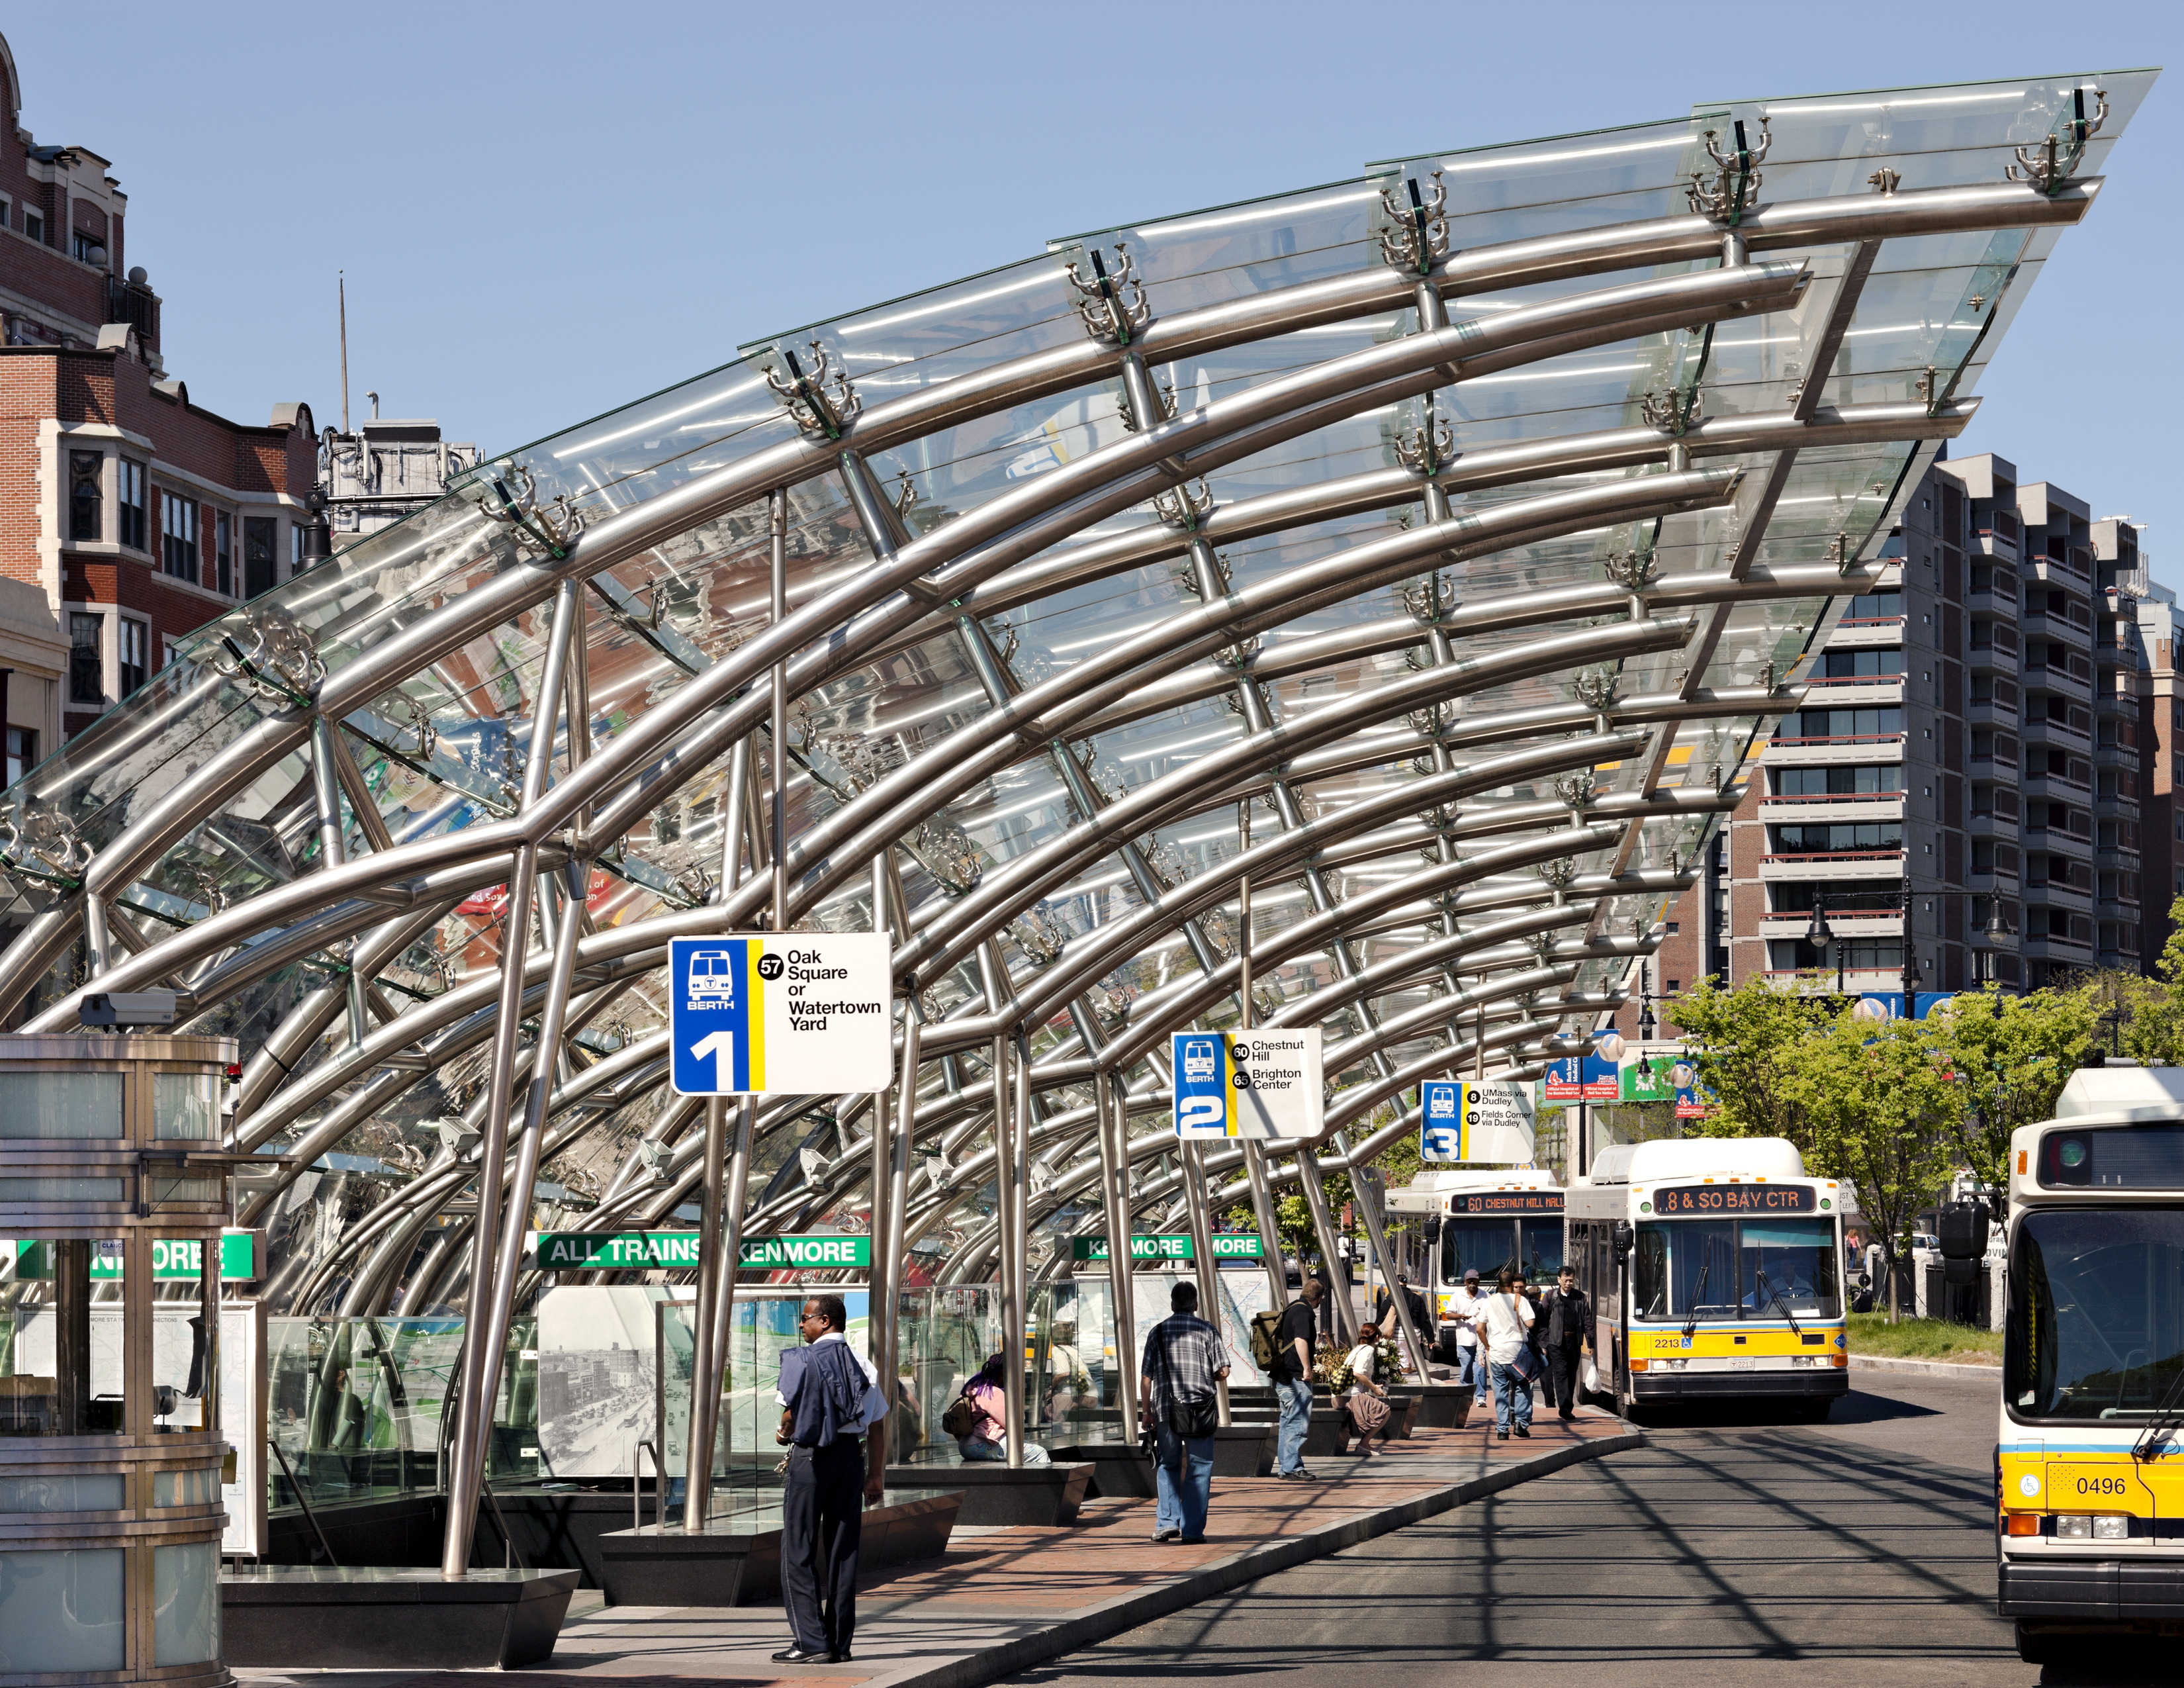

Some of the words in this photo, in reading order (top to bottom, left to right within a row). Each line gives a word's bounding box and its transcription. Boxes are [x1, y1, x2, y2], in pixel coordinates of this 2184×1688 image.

[594, 878, 605, 888] of
[788, 950, 822, 964] Oak
[760, 960, 781, 974] 57
[788, 966, 848, 982] Square
[788, 984, 805, 996] or
[687, 1000, 734, 1010] BERTH
[788, 1001, 881, 1015] Watertown
[789, 1017, 827, 1031] Yard
[1252, 1040, 1304, 1050] Chestnut
[1234, 1047, 1247, 1057] 60
[1252, 1051, 1269, 1061] Hill
[690, 1031, 734, 1092] 1
[1234, 1075, 1248, 1086] 65
[1252, 1069, 1301, 1080] Brighton
[1253, 1080, 1291, 1090] Center
[1470, 1093, 1477, 1102] 8
[1482, 1098, 1512, 1106] Dudley
[1179, 1096, 1224, 1138] 2
[1494, 1119, 1520, 1128] Dudley
[1424, 1128, 1458, 1160] 3
[1468, 1197, 1482, 1212] 60
[1485, 1197, 1524, 1209] CHESTNUT
[1526, 1197, 1543, 1208] HILL
[1545, 1197, 1565, 1207] MALL
[1668, 1192, 1678, 1211] 8
[1682, 1193, 1694, 1208] &
[1698, 1192, 1722, 1208] SO
[1727, 1192, 1762, 1207] BAY
[1766, 1192, 1799, 1207] CTR
[550, 1240, 601, 1261] ALL
[608, 1239, 700, 1261] TRAINS
[739, 1241, 856, 1262] KENMORE
[1089, 1239, 1183, 1255] KEMORE
[1655, 1338, 1679, 1348] 2213
[2077, 1477, 2126, 1494] 0496
